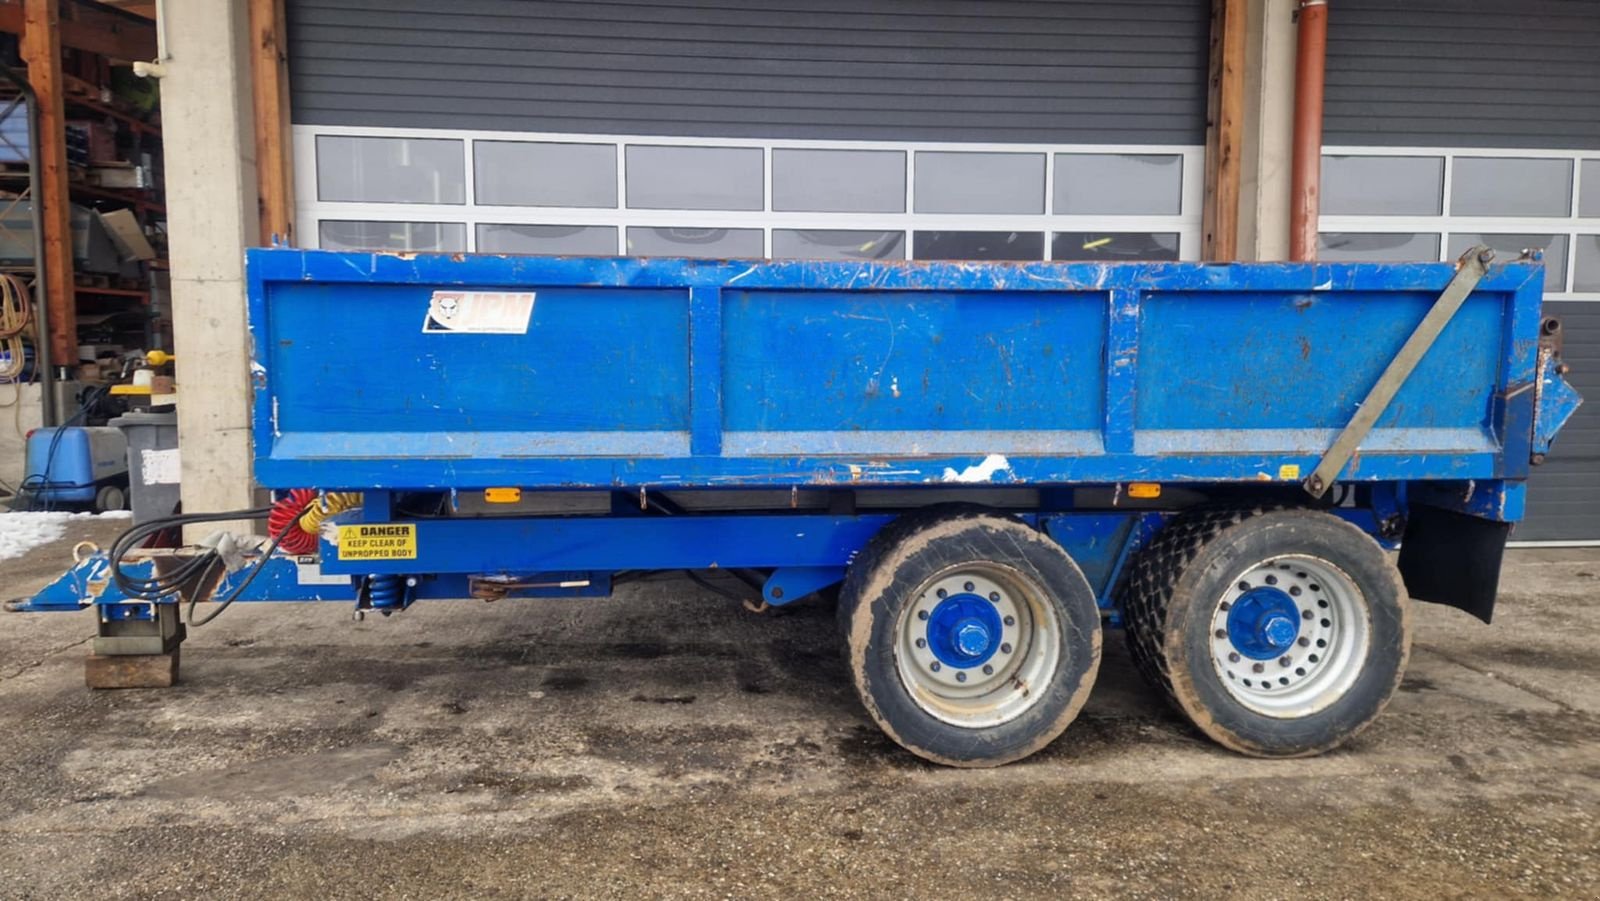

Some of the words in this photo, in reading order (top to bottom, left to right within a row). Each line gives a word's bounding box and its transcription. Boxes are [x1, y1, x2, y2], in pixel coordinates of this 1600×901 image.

[361, 526, 410, 536] DANGER
[369, 539, 395, 547] CLEAR
[397, 539, 406, 547] OF
[342, 549, 389, 557] UNPROPPED
[391, 549, 412, 557] BODY
